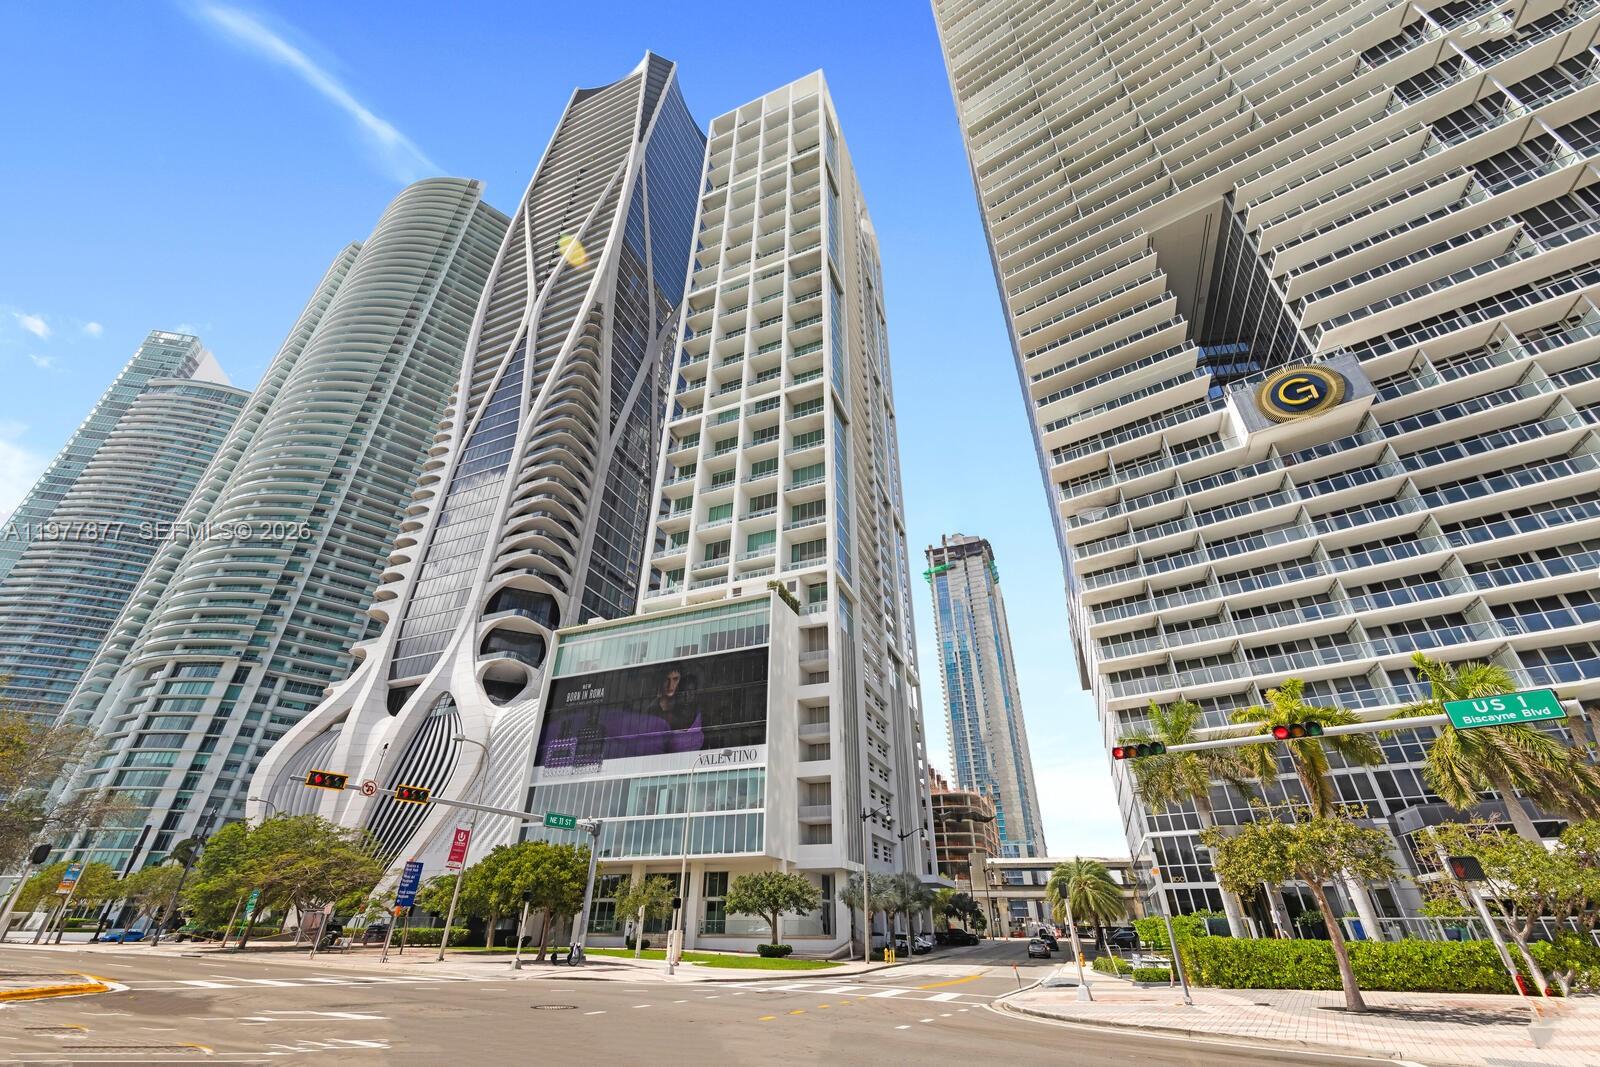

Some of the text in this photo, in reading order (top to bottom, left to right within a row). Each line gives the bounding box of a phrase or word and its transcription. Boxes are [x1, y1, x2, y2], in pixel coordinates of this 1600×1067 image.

[566, 692, 580, 702] BORN
[582, 690, 588, 700] IN
[589, 688, 604, 699] ROMA
[1472, 695, 1527, 713] US 1
[1463, 706, 1551, 725] Biscayne Blvd
[699, 749, 758, 765] VALENTINO
